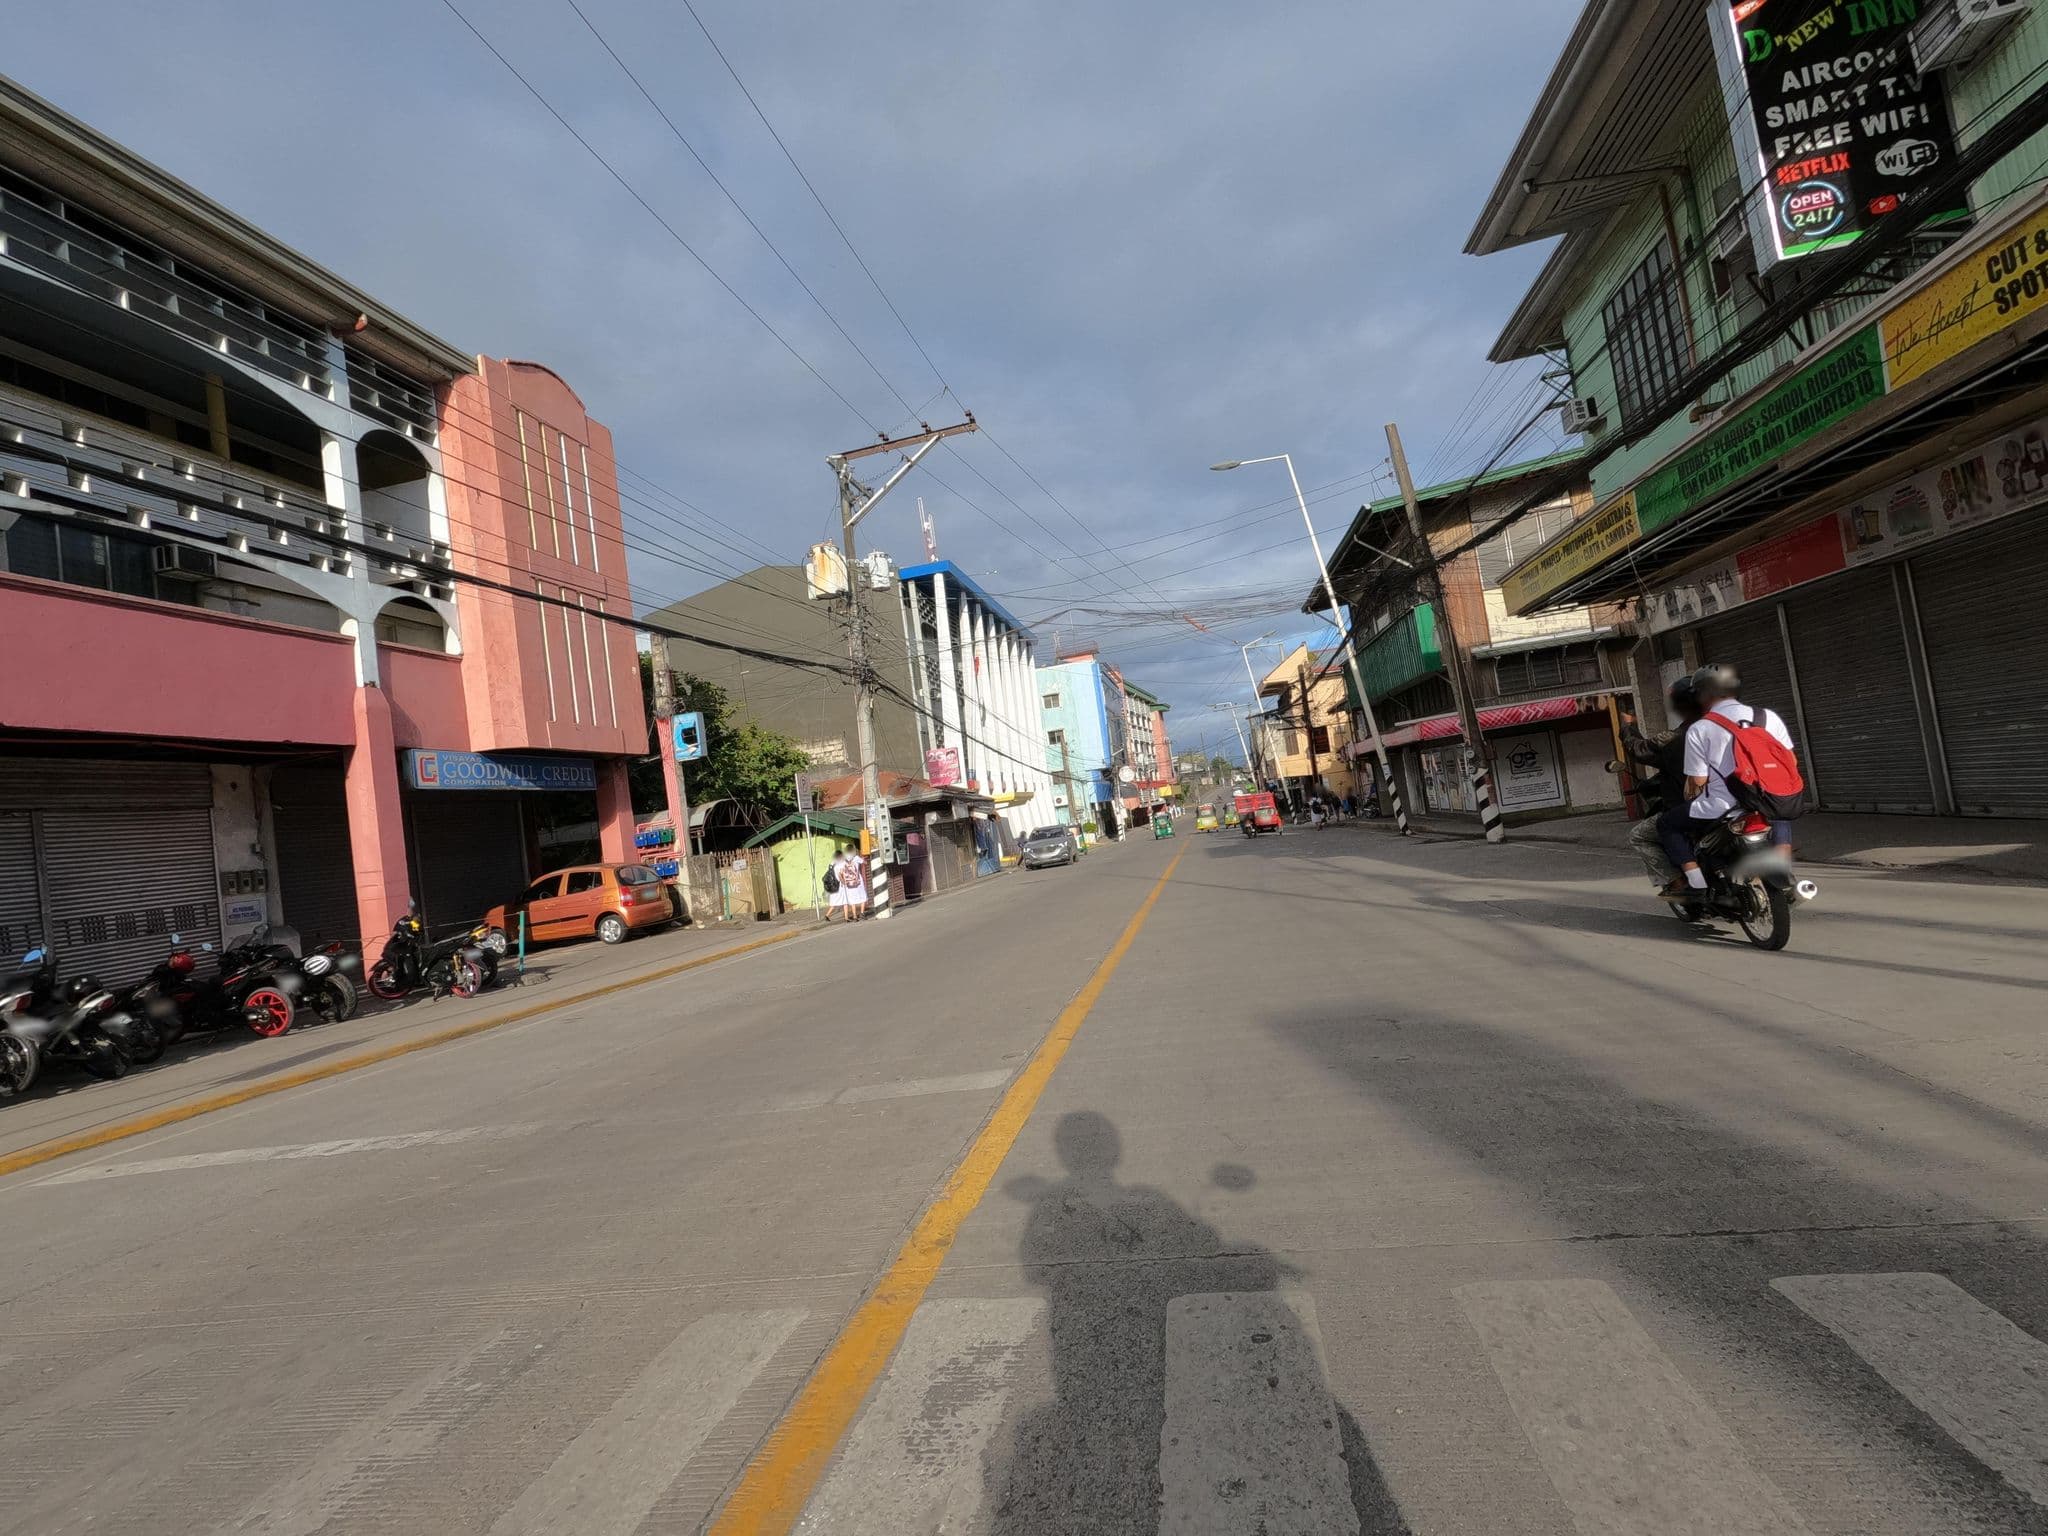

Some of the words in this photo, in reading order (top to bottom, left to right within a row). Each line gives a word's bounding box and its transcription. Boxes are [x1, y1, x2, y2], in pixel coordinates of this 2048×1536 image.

[1743, 28, 1773, 63] D
[1845, 0, 1918, 36] INN
[1781, 47, 1898, 94] AIRCON
[1765, 86, 1870, 128] SMART
[1773, 121, 1854, 160] FREE
[1861, 103, 1931, 138] WIFI
[1775, 151, 1851, 186] NETFLIX
[1789, 190, 1833, 210] OPEN
[1792, 206, 1834, 229] 24/7
[1985, 236, 2028, 284] CUT
[2033, 229, 2048, 256] &
[1926, 279, 1979, 345] Accept
[1760, 387, 1807, 428] SCHOOL
[1807, 347, 1868, 400] RIBBONS
[1699, 464, 1726, 491] PLATE
[1728, 450, 1750, 474] PVC
[1749, 441, 1762, 462] ID
[1763, 428, 1785, 457] AND
[1785, 383, 1857, 447] LAMINATED
[1858, 369, 1876, 396] ID
[443, 761, 538, 780] GOODWILL
[542, 766, 592, 781] CREDIT
